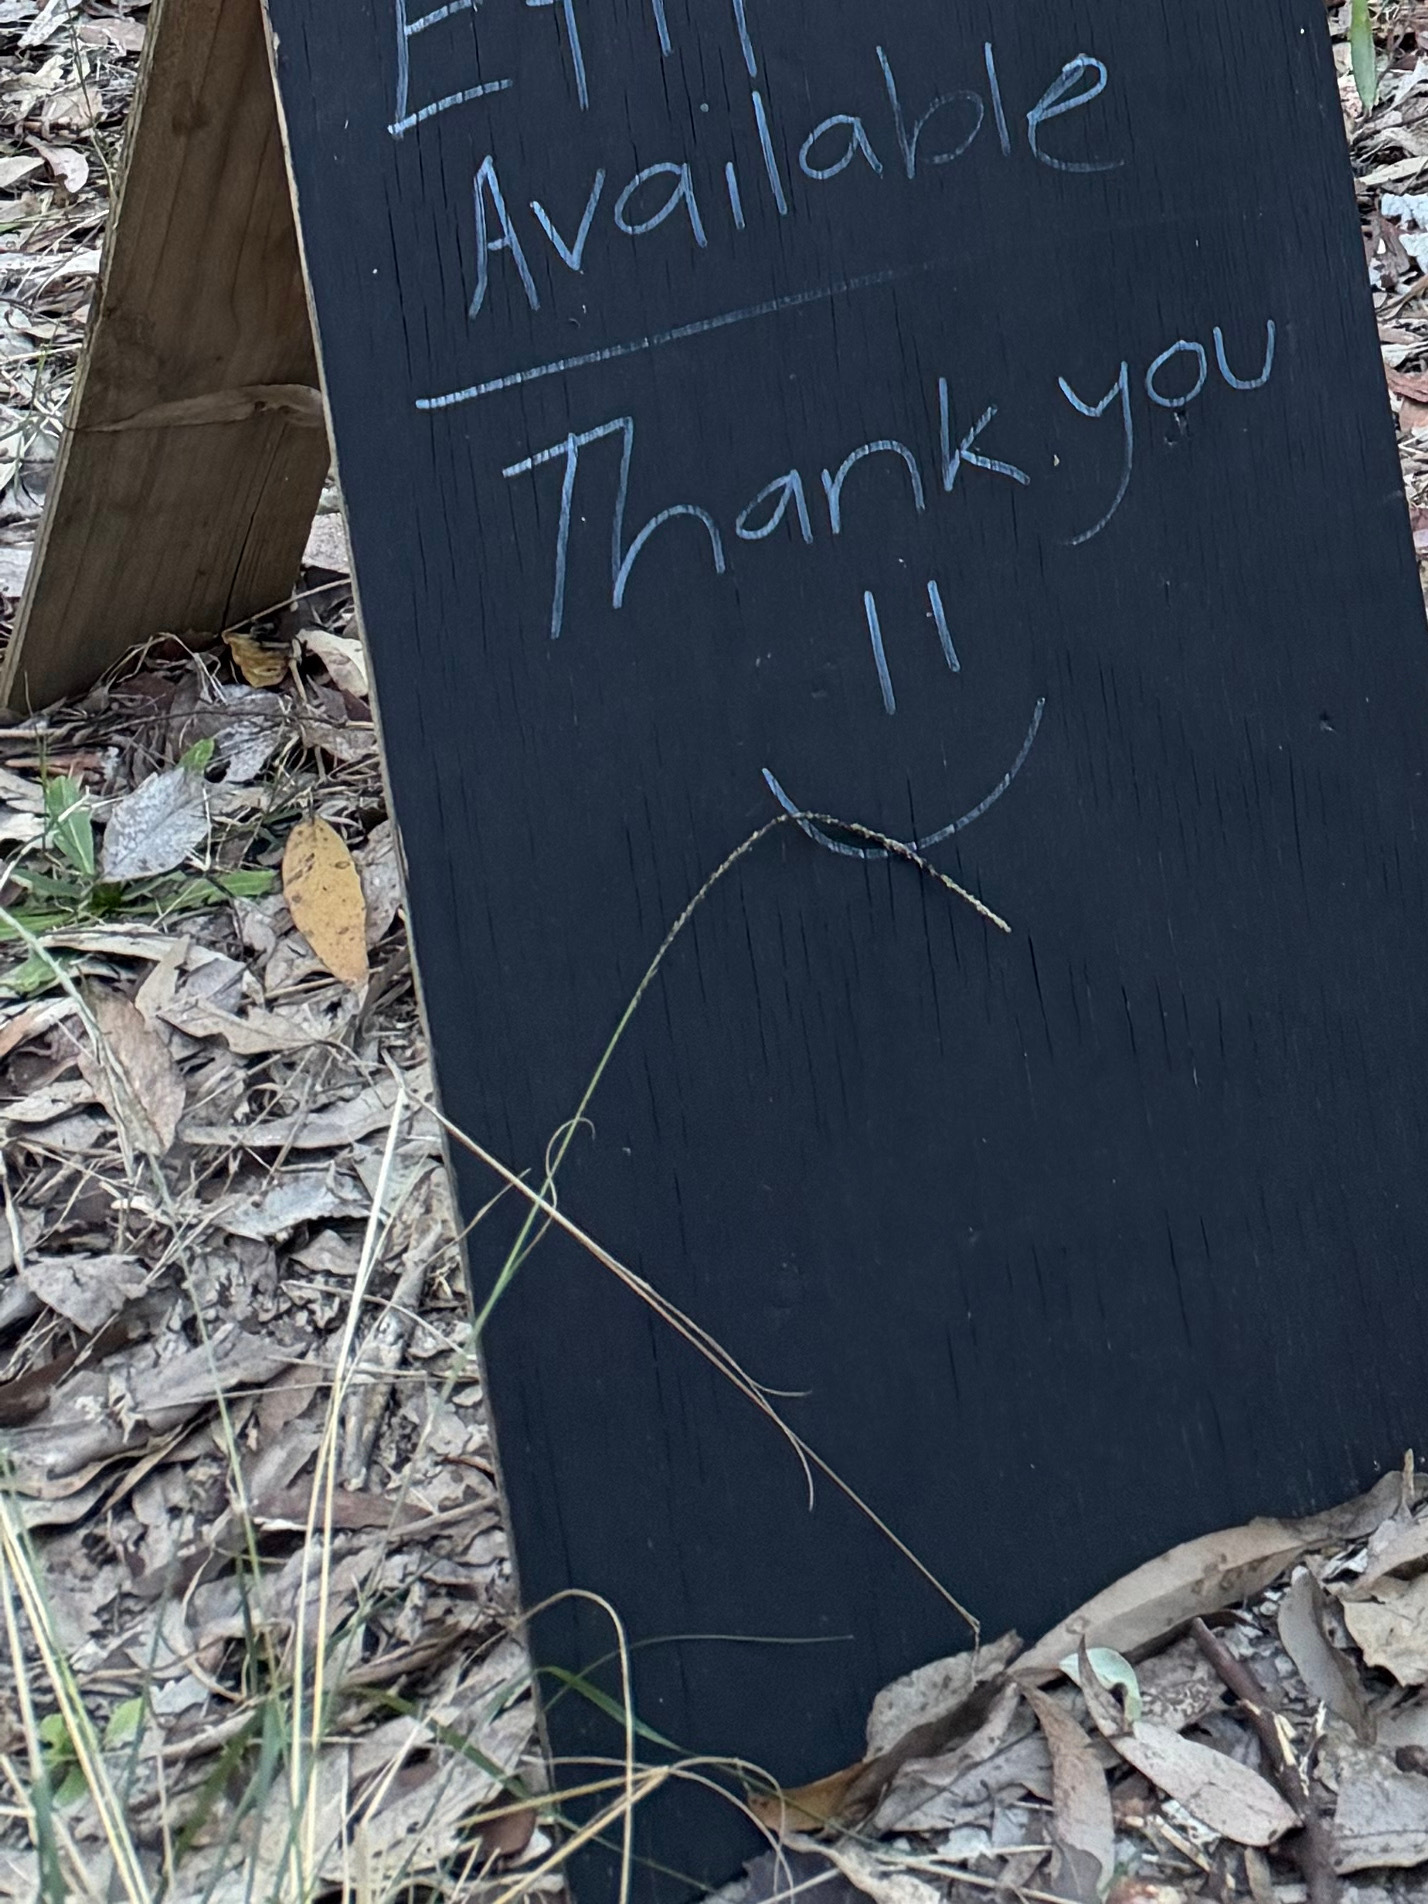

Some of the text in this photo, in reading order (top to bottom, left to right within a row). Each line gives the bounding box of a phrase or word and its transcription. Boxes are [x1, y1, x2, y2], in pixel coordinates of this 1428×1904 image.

[468, 41, 1125, 319] Available
[503, 318, 1276, 640] Thank you
